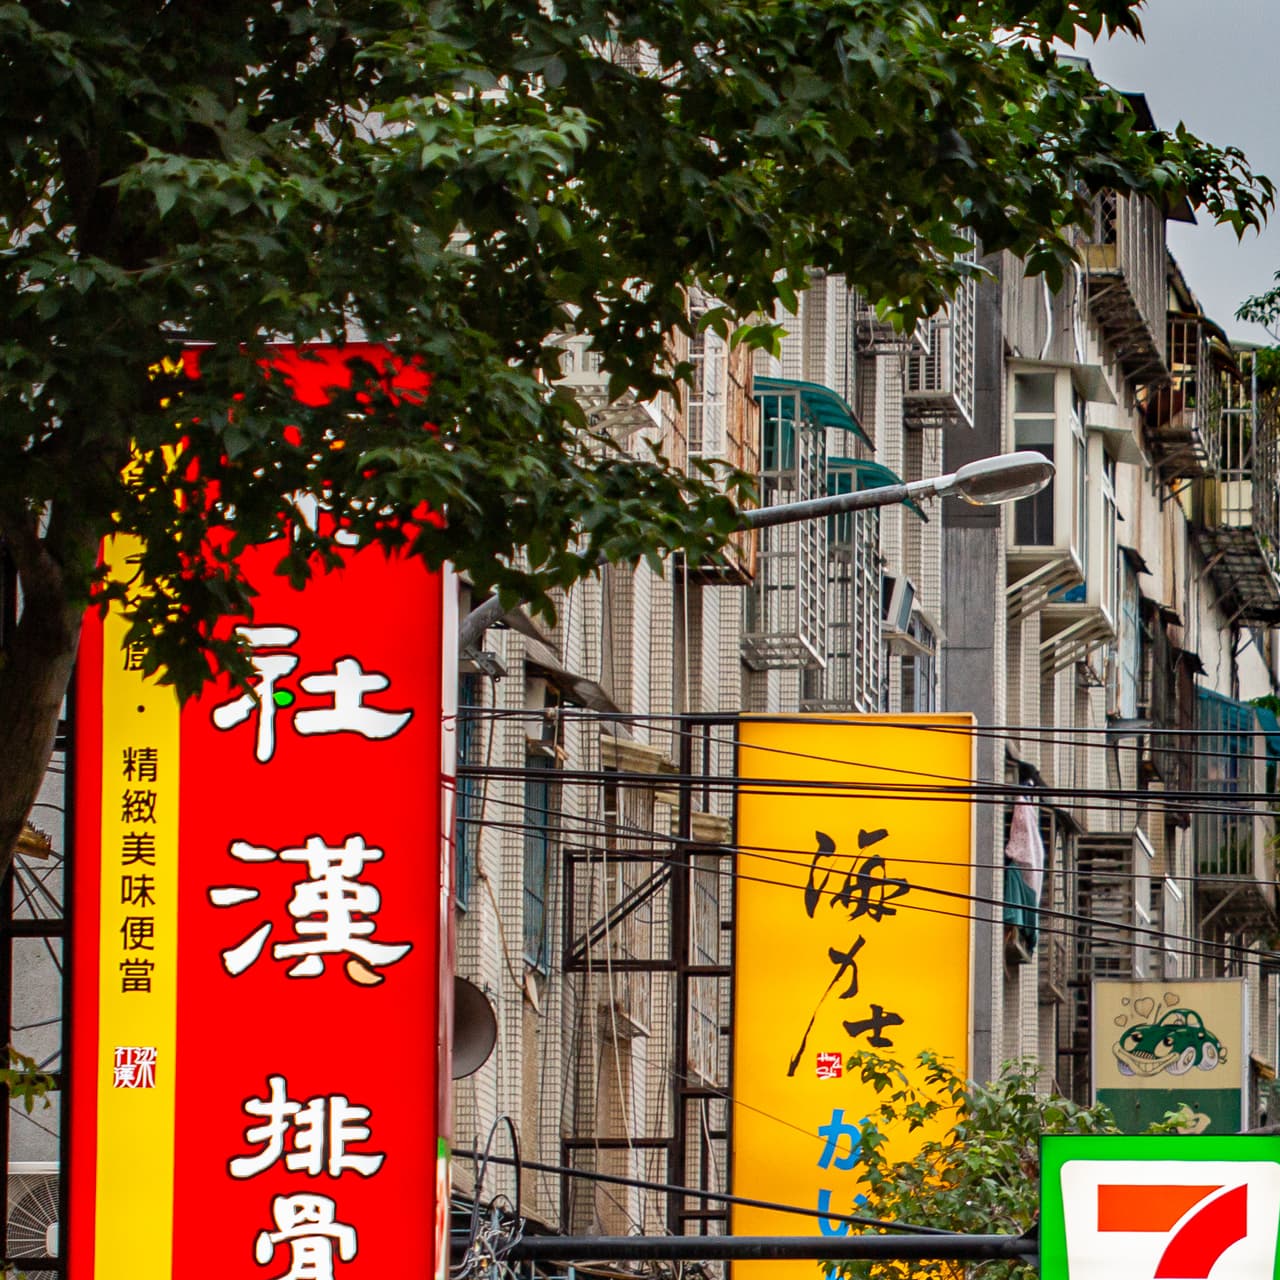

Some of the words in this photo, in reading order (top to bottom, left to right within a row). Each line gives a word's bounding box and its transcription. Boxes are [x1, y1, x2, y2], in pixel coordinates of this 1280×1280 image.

[119, 747, 158, 993] 精緻美味便當
